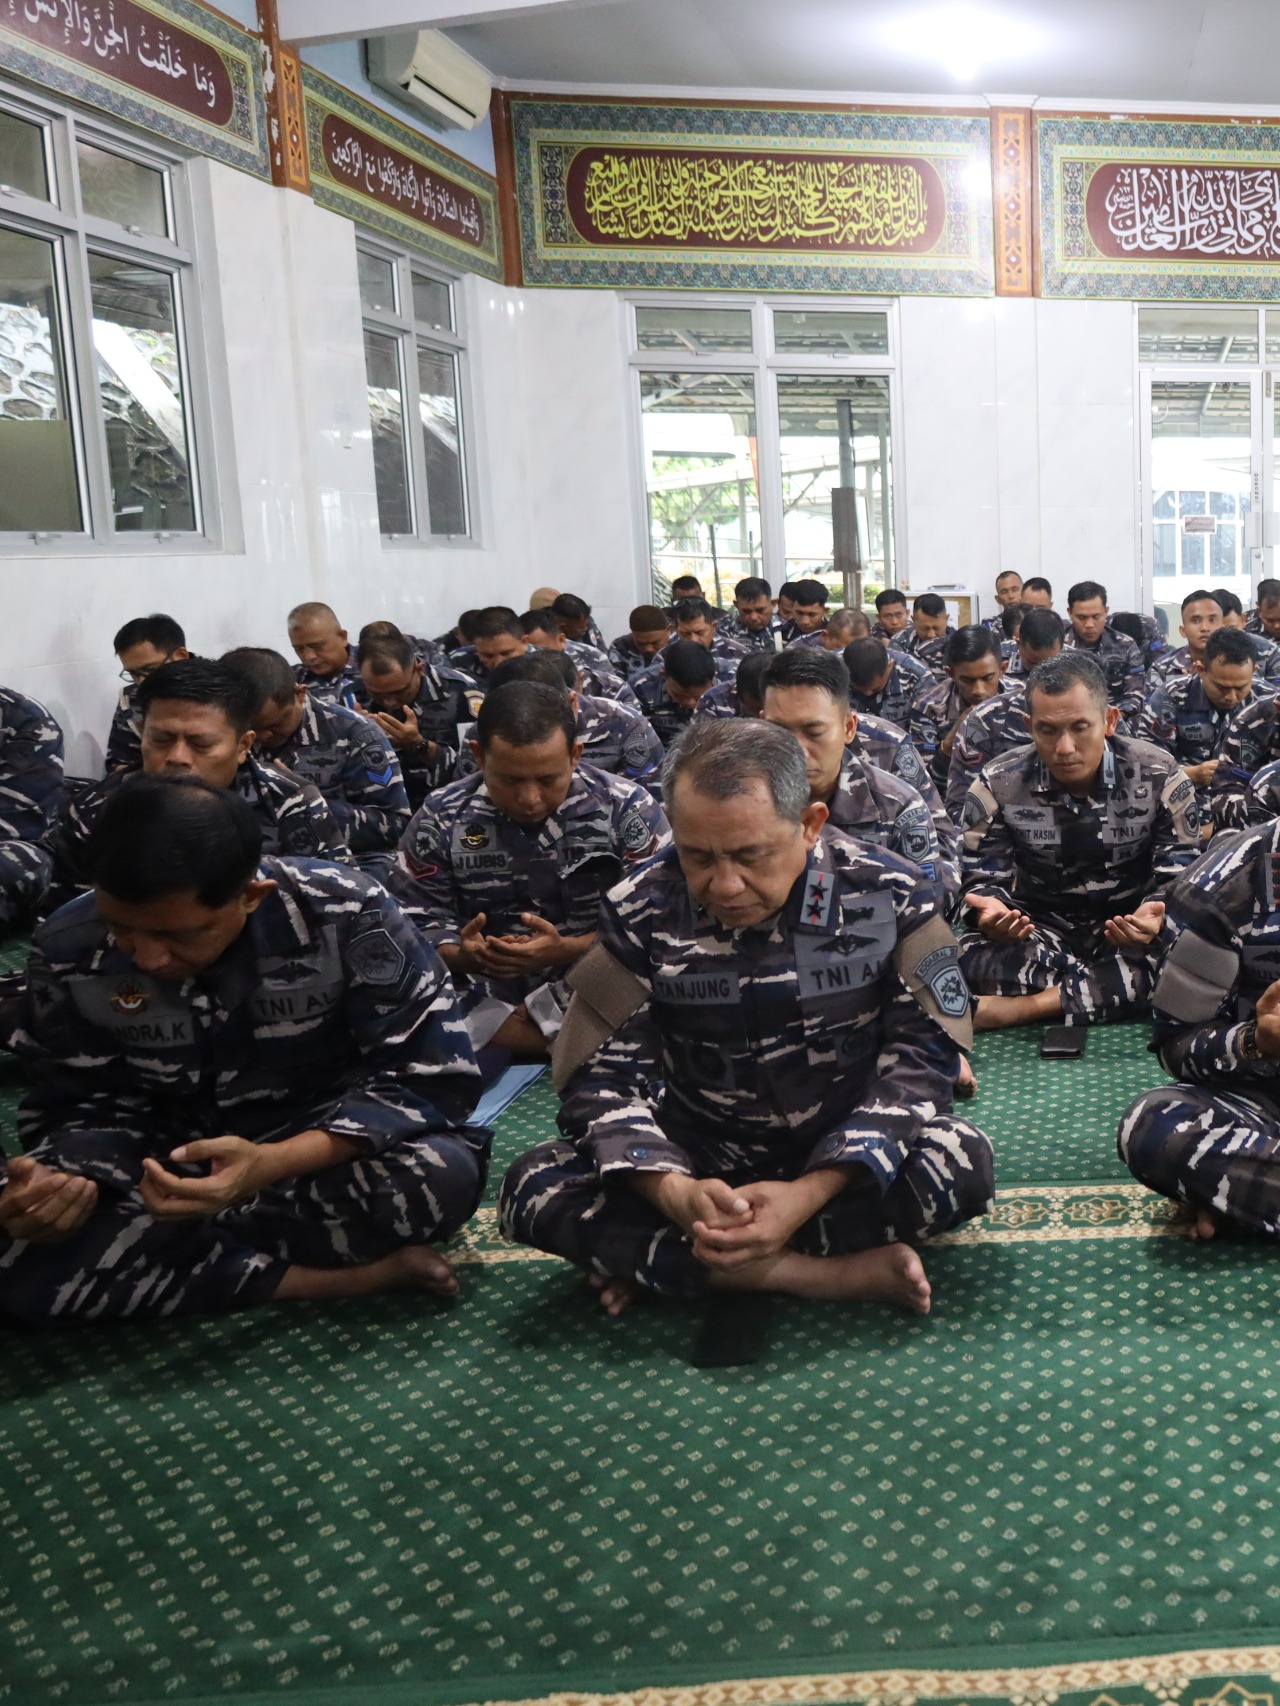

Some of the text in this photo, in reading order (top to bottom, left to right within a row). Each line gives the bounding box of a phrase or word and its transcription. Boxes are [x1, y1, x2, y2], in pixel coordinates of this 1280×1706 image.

[1033, 829, 1056, 840] HASIM
[1110, 826, 1133, 838] TNI
[465, 853, 507, 869] LUBIS
[810, 965, 842, 991] TNI
[656, 978, 730, 1001] TANJUNG
[256, 991, 336, 1018] TNI AL
